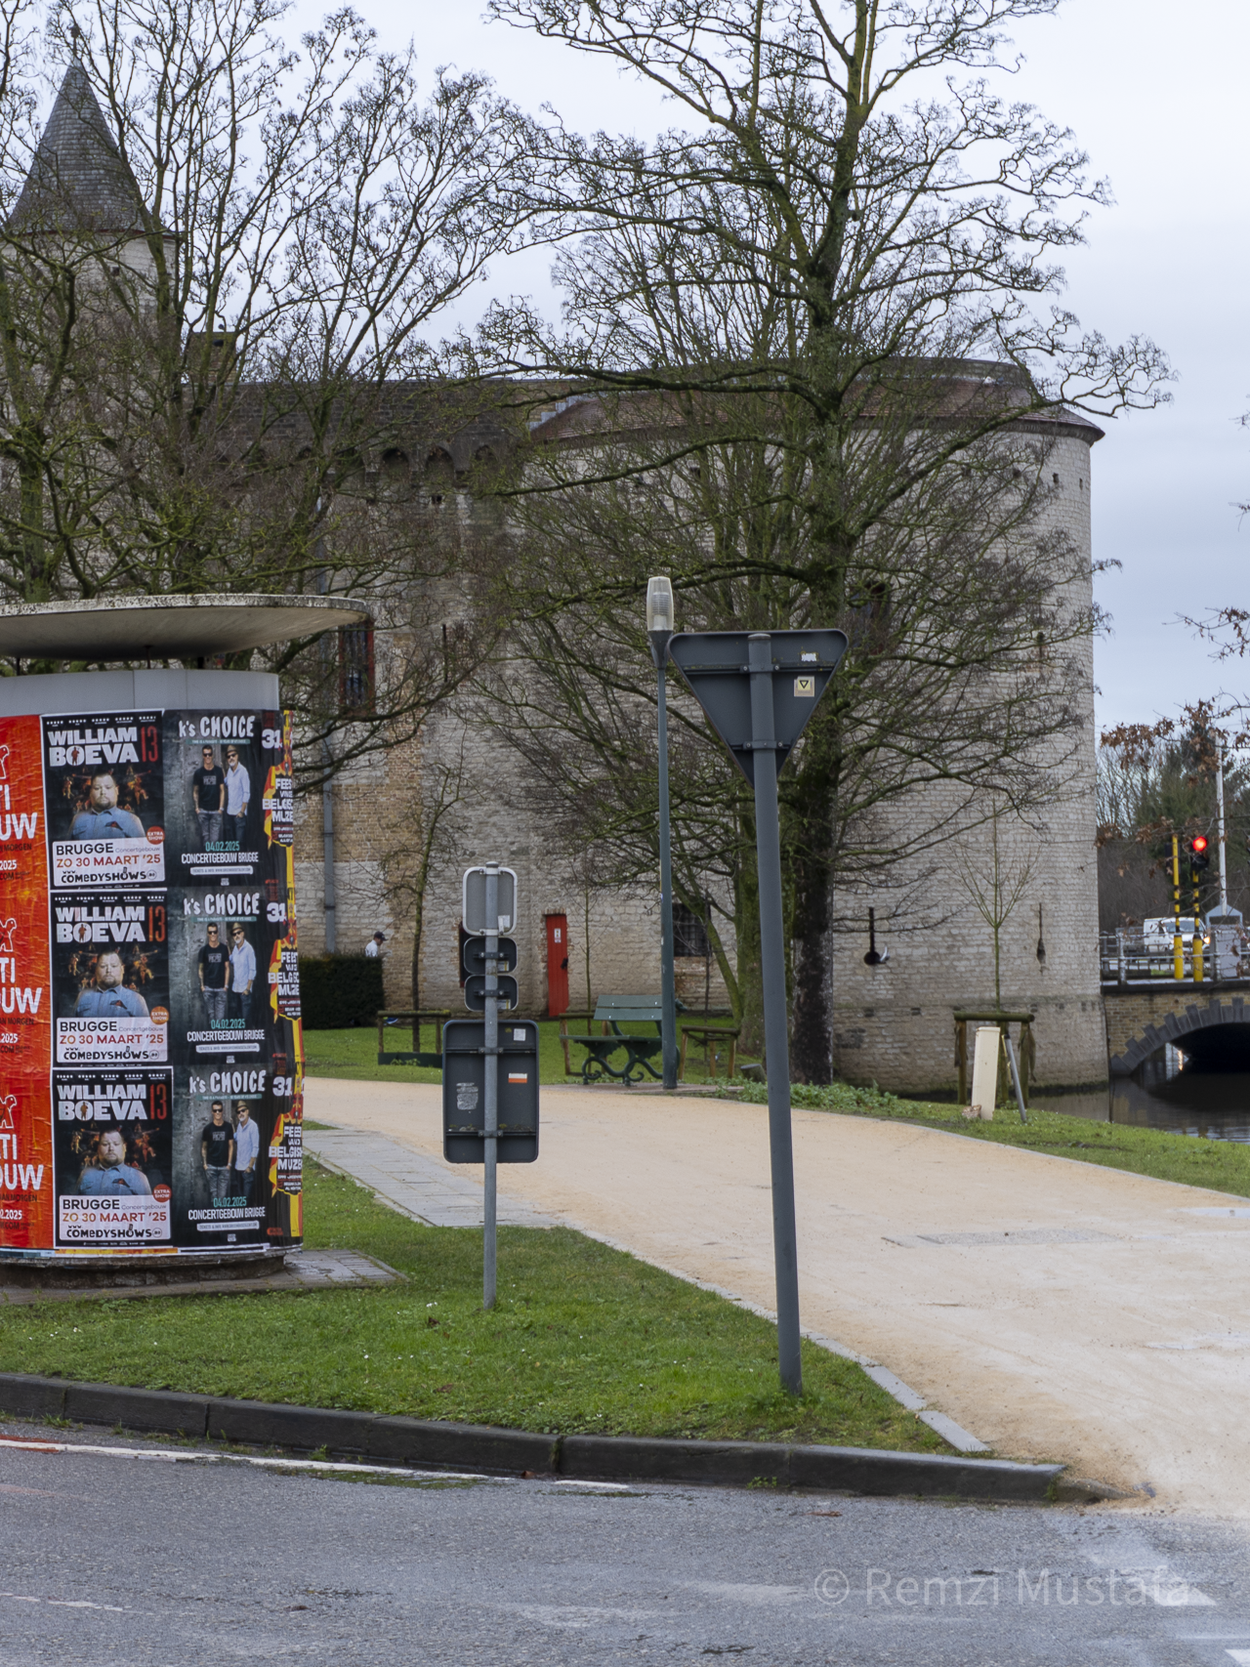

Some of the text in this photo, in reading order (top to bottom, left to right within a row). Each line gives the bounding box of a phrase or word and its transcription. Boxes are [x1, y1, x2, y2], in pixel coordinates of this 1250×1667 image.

[200, 715, 255, 738] CHOICE
[48, 726, 138, 746] WILLIAM
[140, 726, 158, 762] 13
[49, 743, 139, 767] BOEVA
[56, 843, 113, 855] BRUGGE
[206, 841, 240, 852] 04.02.2025
[56, 854, 161, 868] ZO 30 MAART '25
[181, 852, 259, 864] CONCERTGEBOUW BRUGGE
[205, 892, 260, 915] CHOICE
[55, 906, 145, 922] WILLIAM
[148, 905, 166, 942] 13
[56, 922, 146, 943] BOEVA
[60, 1021, 117, 1032] BRUGGE
[211, 1018, 246, 1029] 04.02.2025
[60, 1034, 164, 1044] ZO 30 MAART '25
[187, 1029, 265, 1042] CONCERTGEBOUW BRUGGE
[210, 1069, 266, 1093] CHOICE
[57, 1084, 146, 1100] WILLIAM
[150, 1083, 167, 1120] 13
[58, 1100, 148, 1120] BOEVA
[63, 1199, 120, 1210] BRUGGE
[213, 1196, 247, 1207] 04.02.2025
[62, 1212, 166, 1222] ZO 30 MAART '25
[188, 1207, 266, 1220] CONCERTGEBOUW BRUGGE
